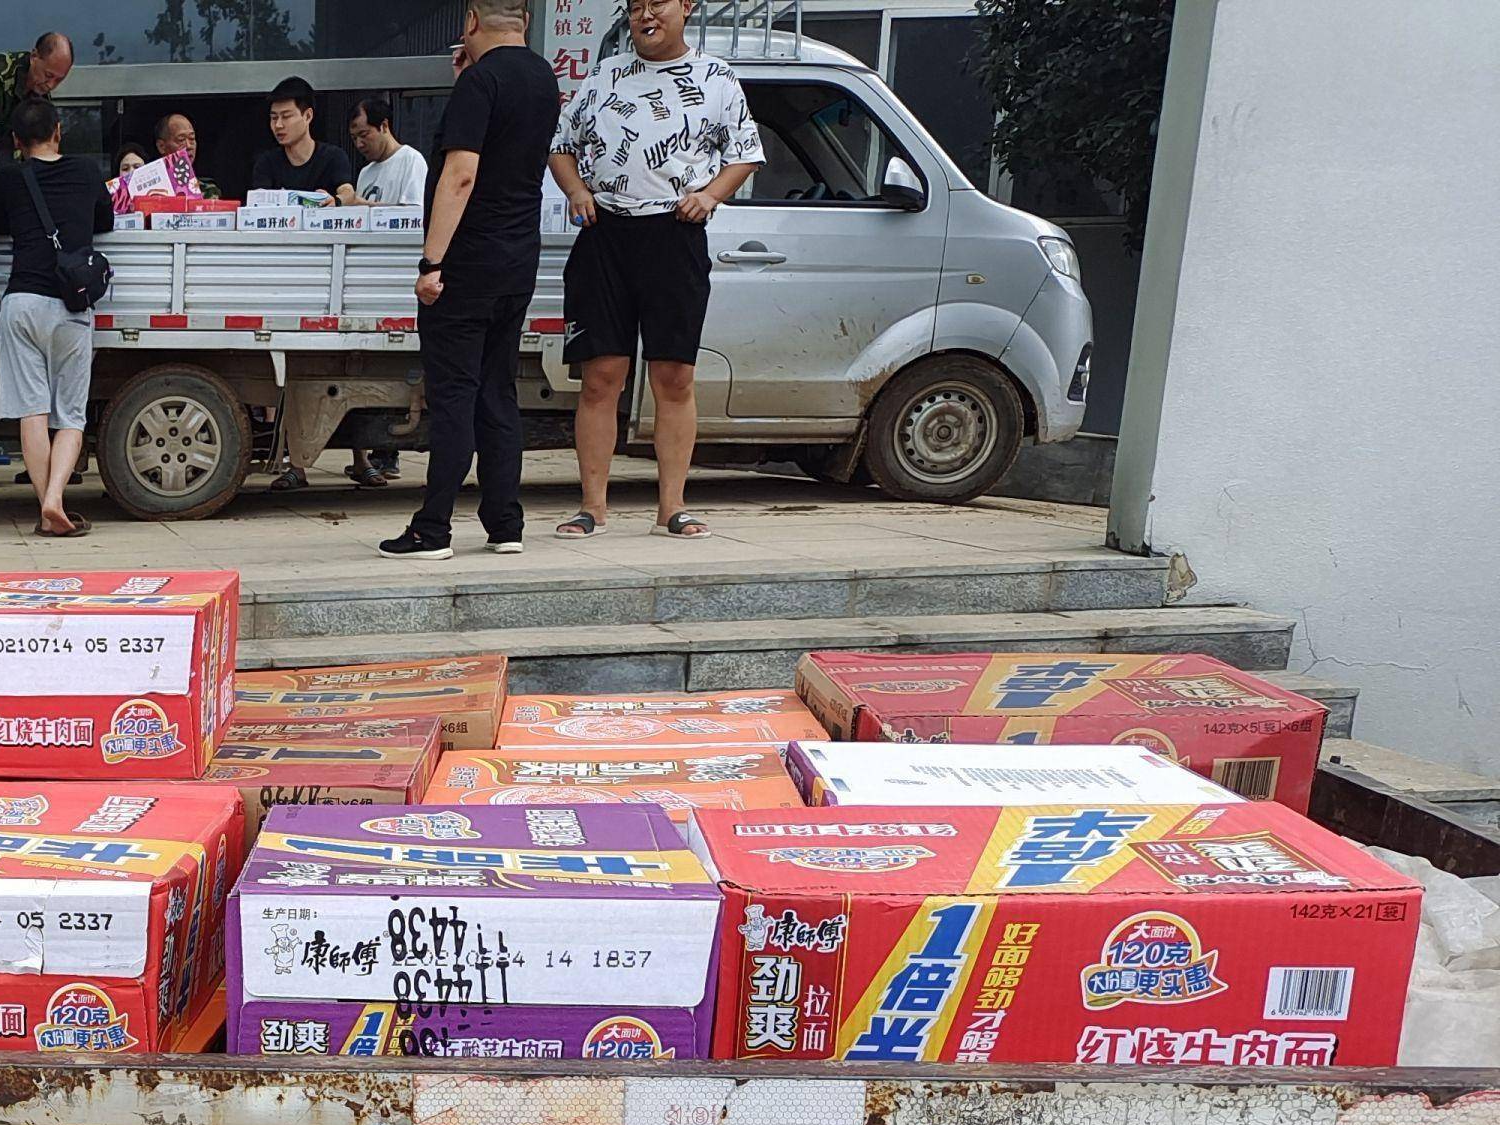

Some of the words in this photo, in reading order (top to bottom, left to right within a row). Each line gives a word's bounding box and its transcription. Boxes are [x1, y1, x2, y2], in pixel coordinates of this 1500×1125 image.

[612, 60, 646, 89] DEATH
[657, 63, 705, 108] DEATH
[599, 92, 638, 120] DEATH
[638, 89, 671, 121] DEATH
[612, 125, 639, 166] DEATH
[643, 114, 691, 170] DEATH
[668, 165, 696, 196] DEATH
[85, 637, 108, 653] 05
[119, 637, 166, 653] 2337
[114, 718, 161, 735] 120克
[995, 808, 1150, 888] 1倍半
[17, 911, 45, 929] 05
[59, 912, 113, 931] 2337
[771, 912, 846, 952] 康師傅
[1129, 922, 1177, 939] 大面饼
[301, 930, 381, 976] 康師傅
[546, 950, 572, 968] 14
[593, 950, 650, 968] 1837
[1108, 941, 1191, 965] 120克
[845, 903, 982, 1061] 1倍半
[1087, 962, 1211, 996] 大份量更实惠
[51, 1006, 109, 1025] 120克
[746, 956, 801, 1050] 劲爽
[802, 984, 831, 1052] 拉面
[260, 1019, 330, 1054] 劲爽
[587, 1040, 654, 1058] 120克
[1076, 1025, 1337, 1066] 红烧牛肉面
